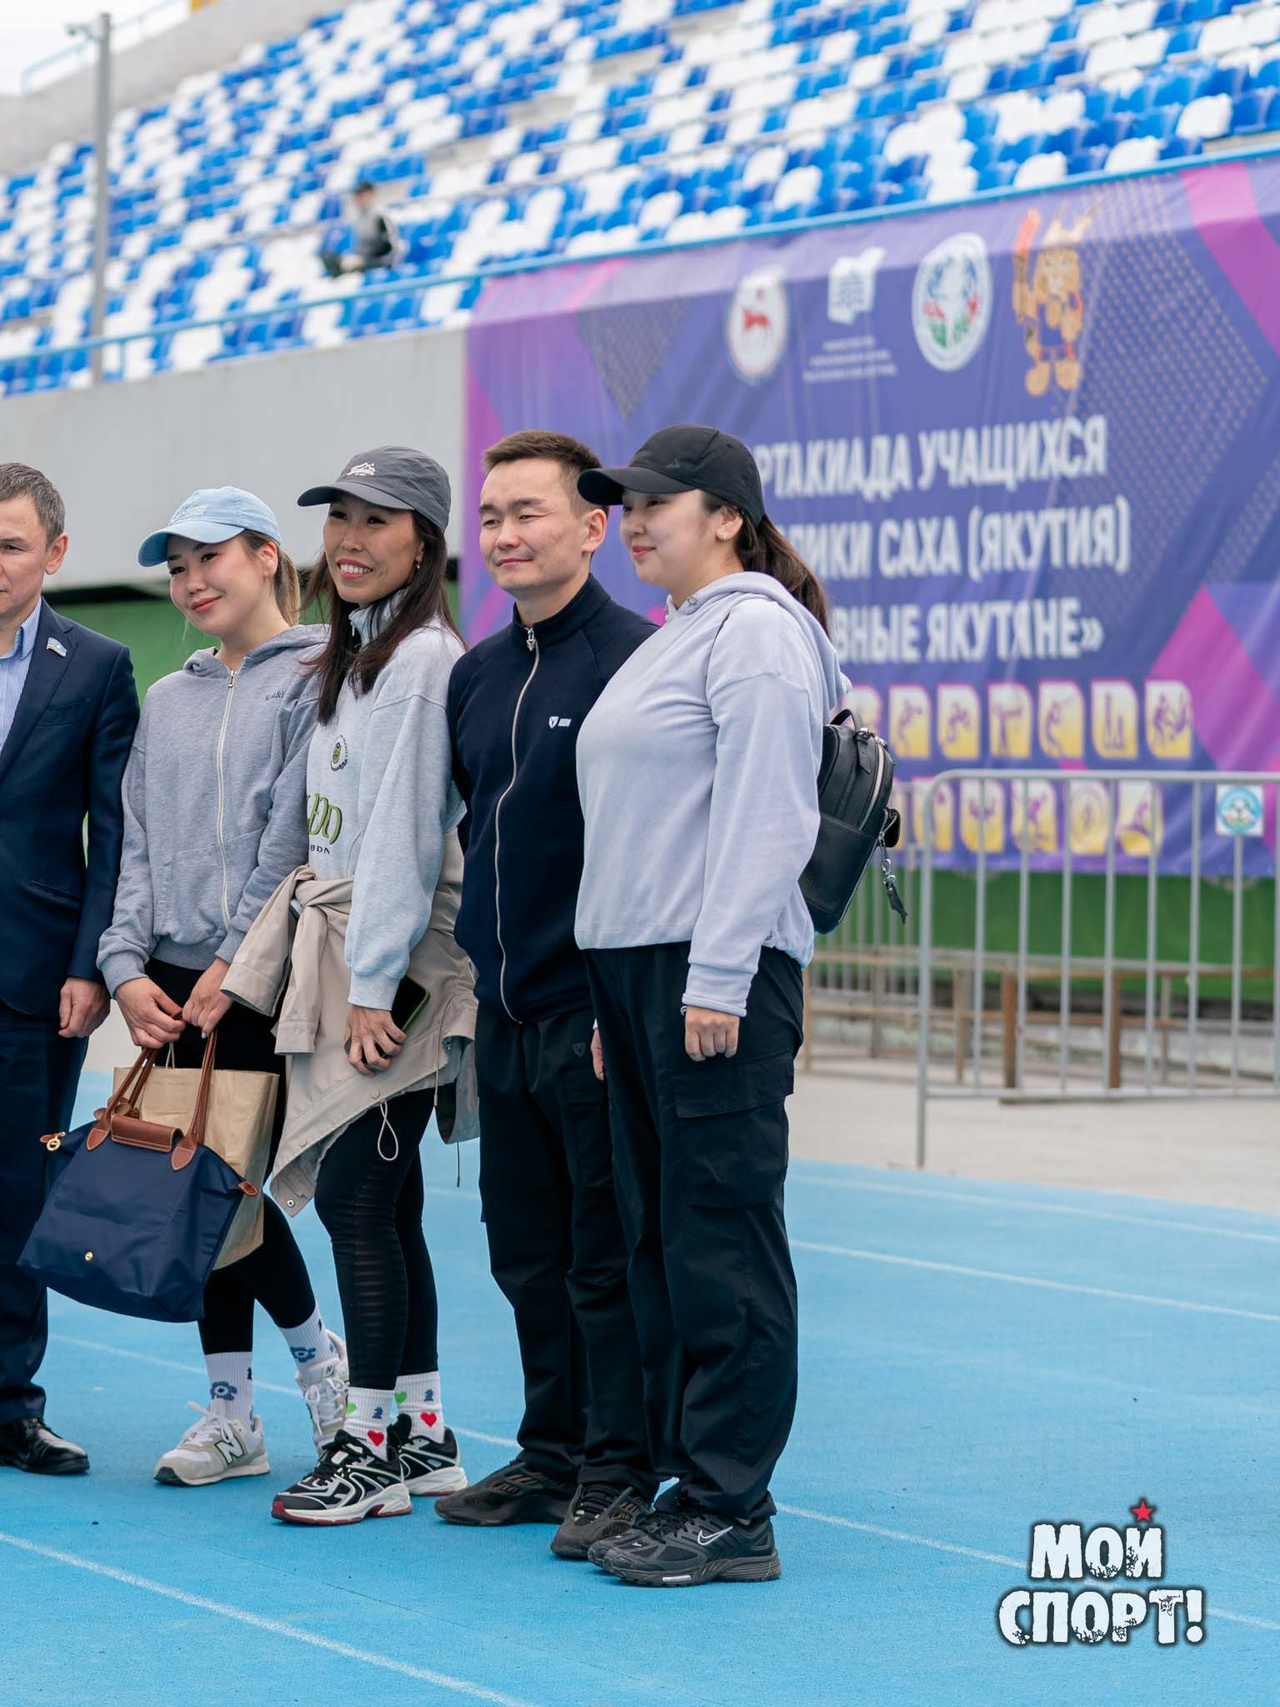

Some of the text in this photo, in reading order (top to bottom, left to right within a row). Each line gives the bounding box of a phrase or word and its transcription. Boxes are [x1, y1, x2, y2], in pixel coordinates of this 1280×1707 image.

[918, 414, 1108, 491] УЧАЩИХСЯ
[878, 515, 962, 580] САХА
[967, 494, 1132, 582] (ЯКУТИЯ)
[926, 596, 1105, 663] ЯКУТЯНЕ»
